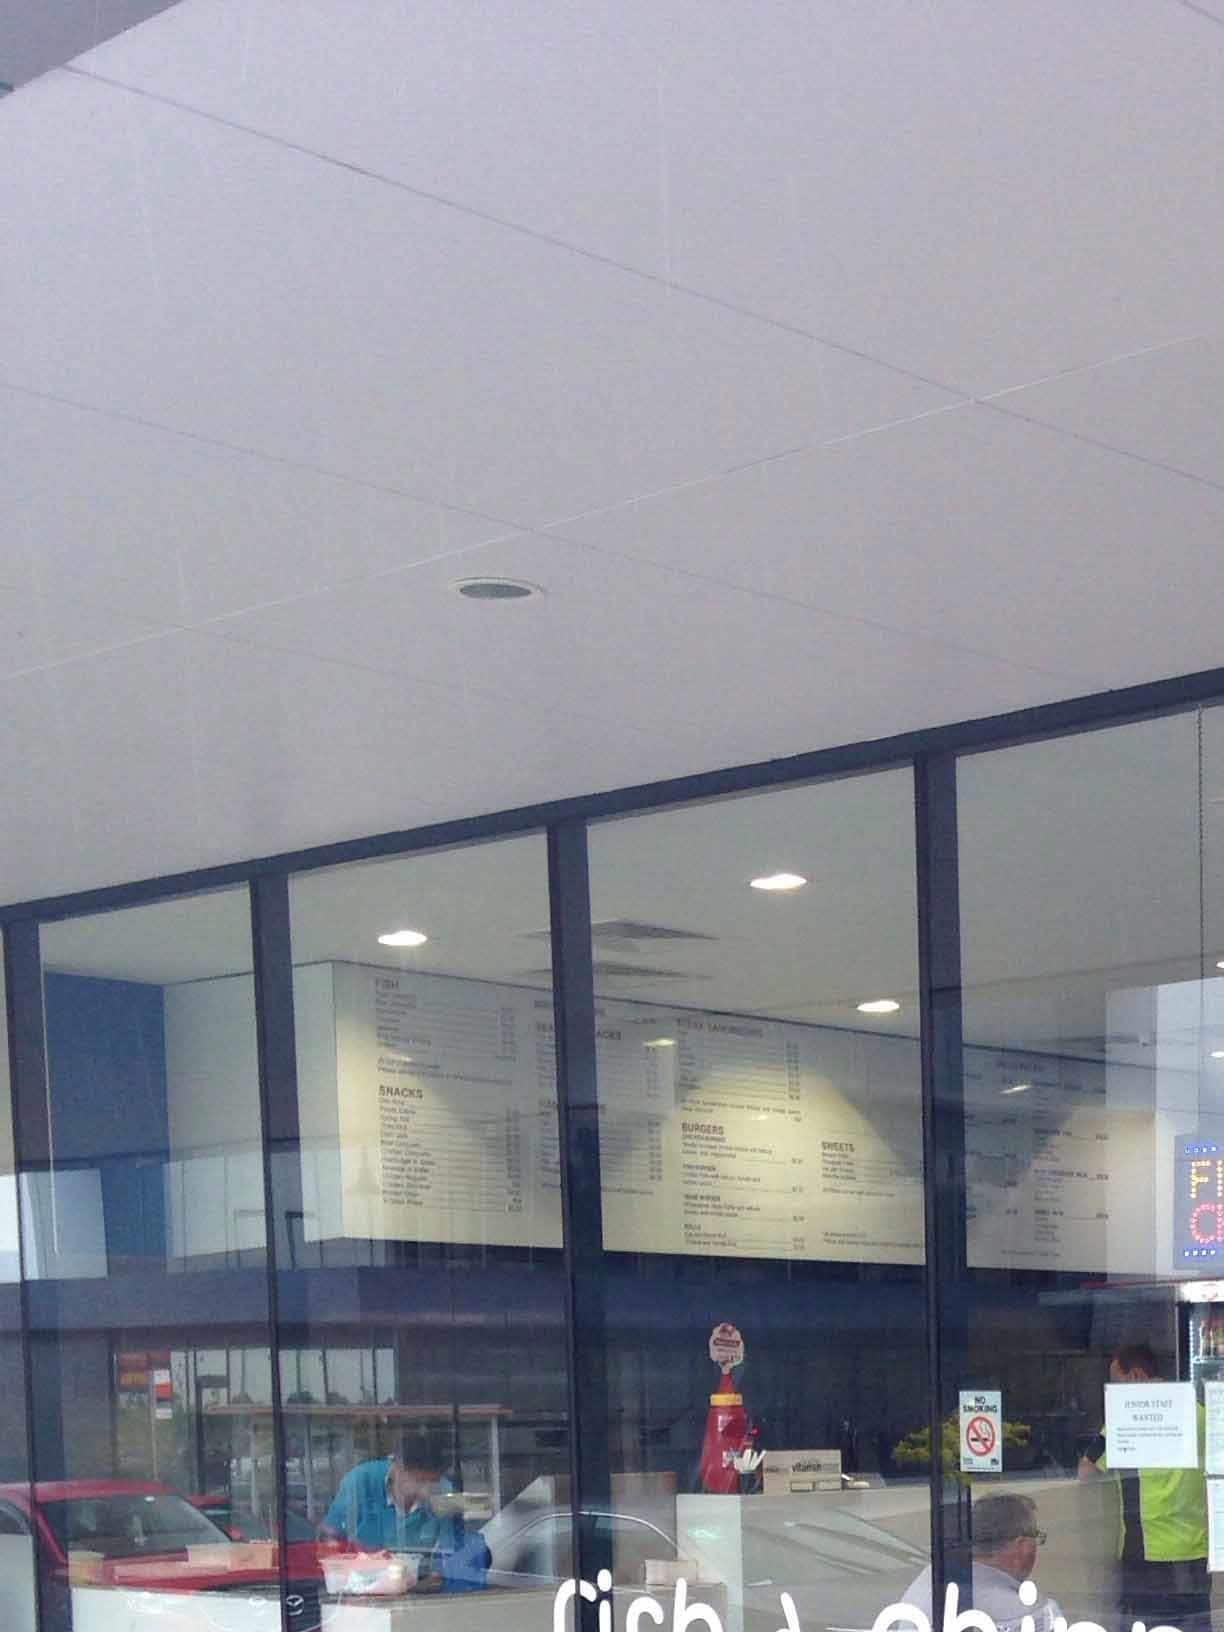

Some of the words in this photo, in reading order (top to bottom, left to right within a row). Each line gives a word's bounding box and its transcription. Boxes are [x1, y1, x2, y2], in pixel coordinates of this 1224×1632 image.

[378, 1085, 424, 1099] SNACKS
[681, 1122, 725, 1136] BURGERS
[821, 1141, 855, 1153] SWEETS
